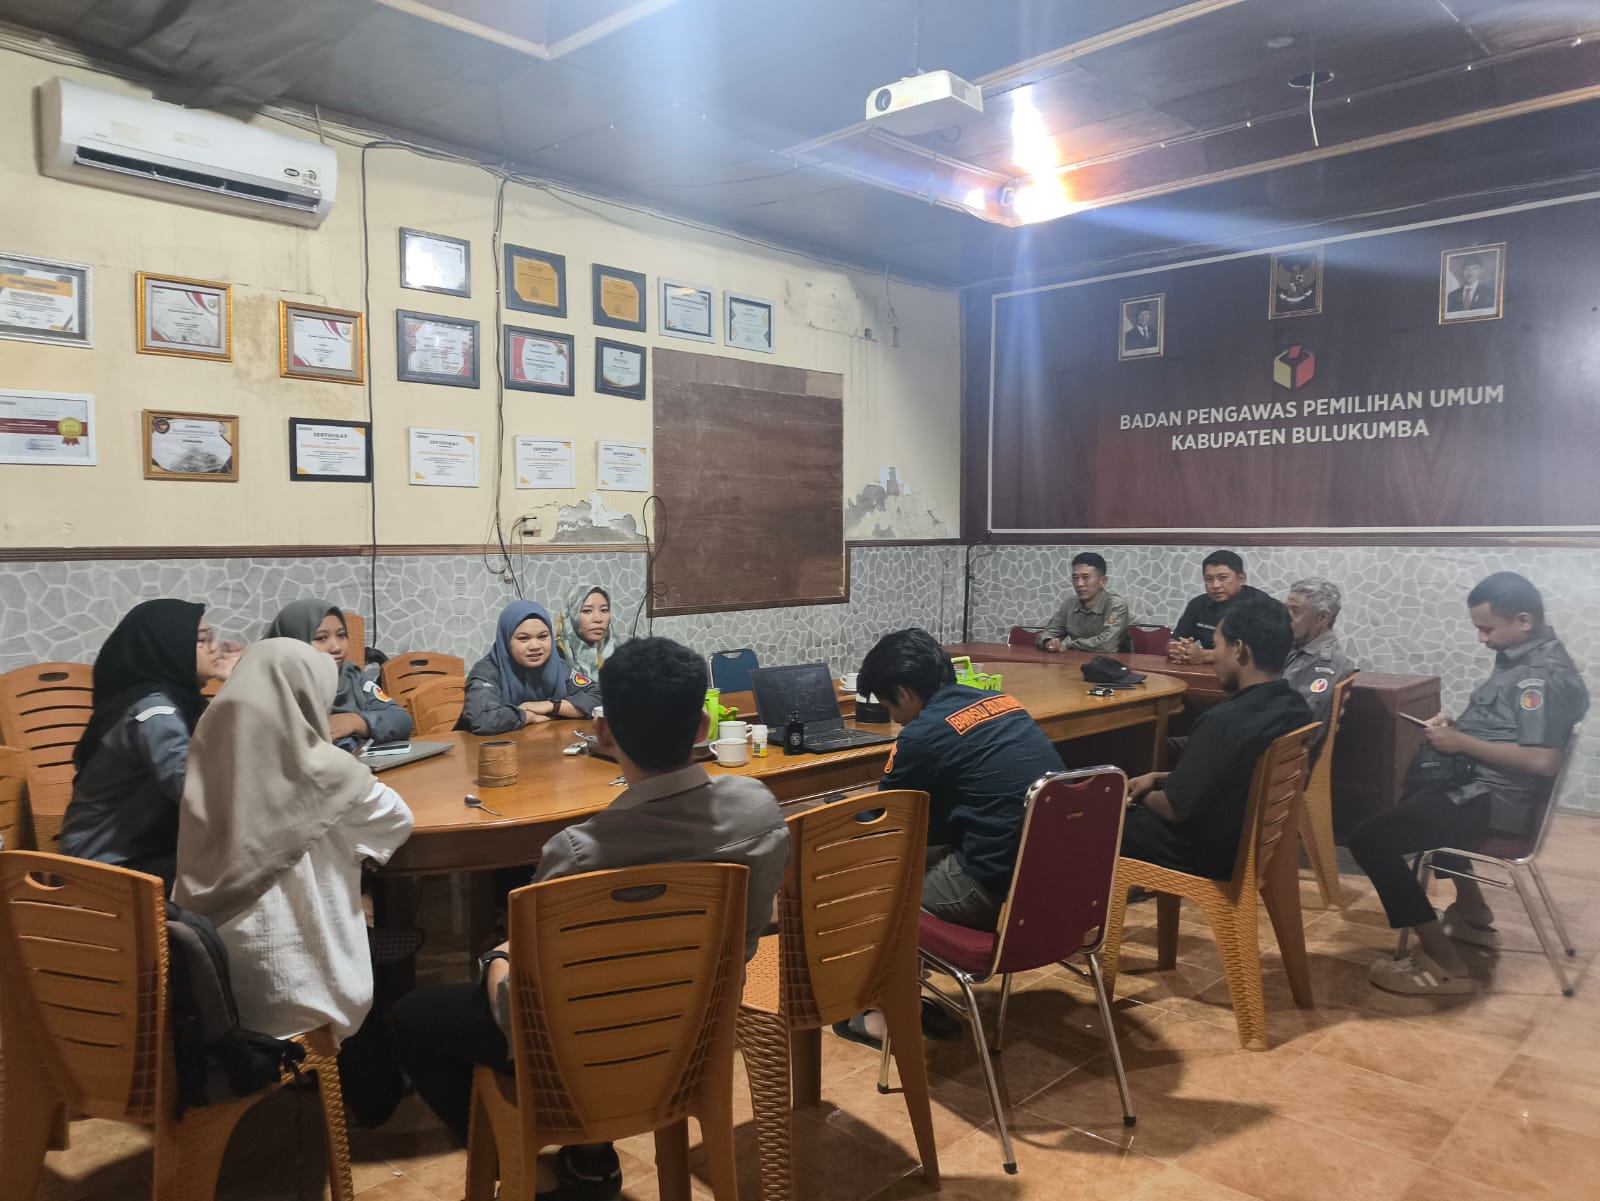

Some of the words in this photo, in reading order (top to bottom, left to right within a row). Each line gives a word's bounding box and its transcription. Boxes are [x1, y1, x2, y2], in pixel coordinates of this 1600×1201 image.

[1119, 410, 1182, 430] BADAN
[1186, 401, 1298, 426] PENGAWAS
[1303, 391, 1423, 417] PEMILIHAN
[1429, 384, 1505, 408] UMUM
[1171, 428, 1286, 451] KABUPATEN
[1292, 418, 1431, 444] BULUKUMBA
